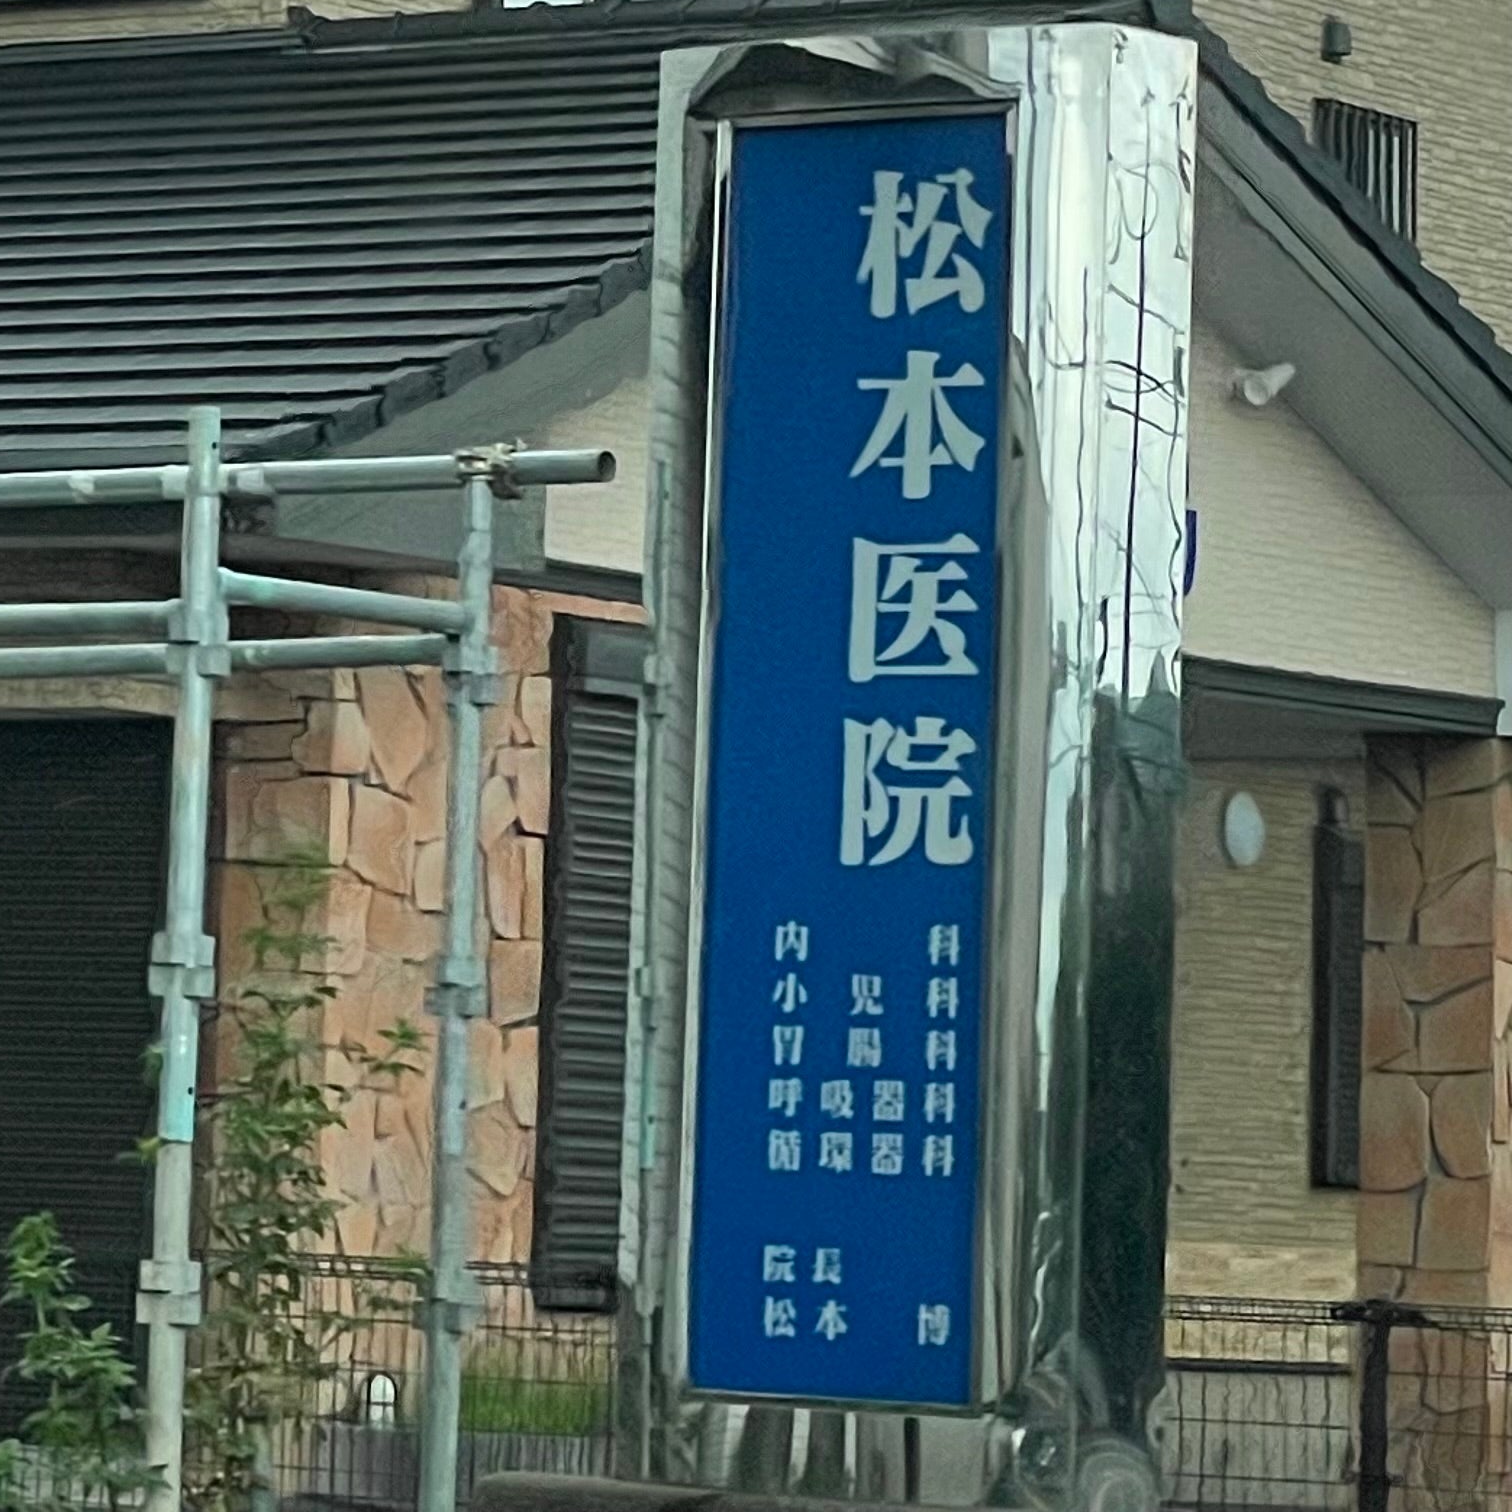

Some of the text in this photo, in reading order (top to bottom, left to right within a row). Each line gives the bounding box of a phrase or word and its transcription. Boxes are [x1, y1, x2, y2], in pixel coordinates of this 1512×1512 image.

[839, 167, 993, 867] 松本医院
[774, 920, 960, 966] 内科
[772, 972, 959, 1019] 小児科
[768, 1077, 956, 1124] 呼吸器科
[768, 1129, 955, 1177] 循環器科
[763, 1244, 842, 1285] 院長
[763, 1295, 848, 1341] 松本
